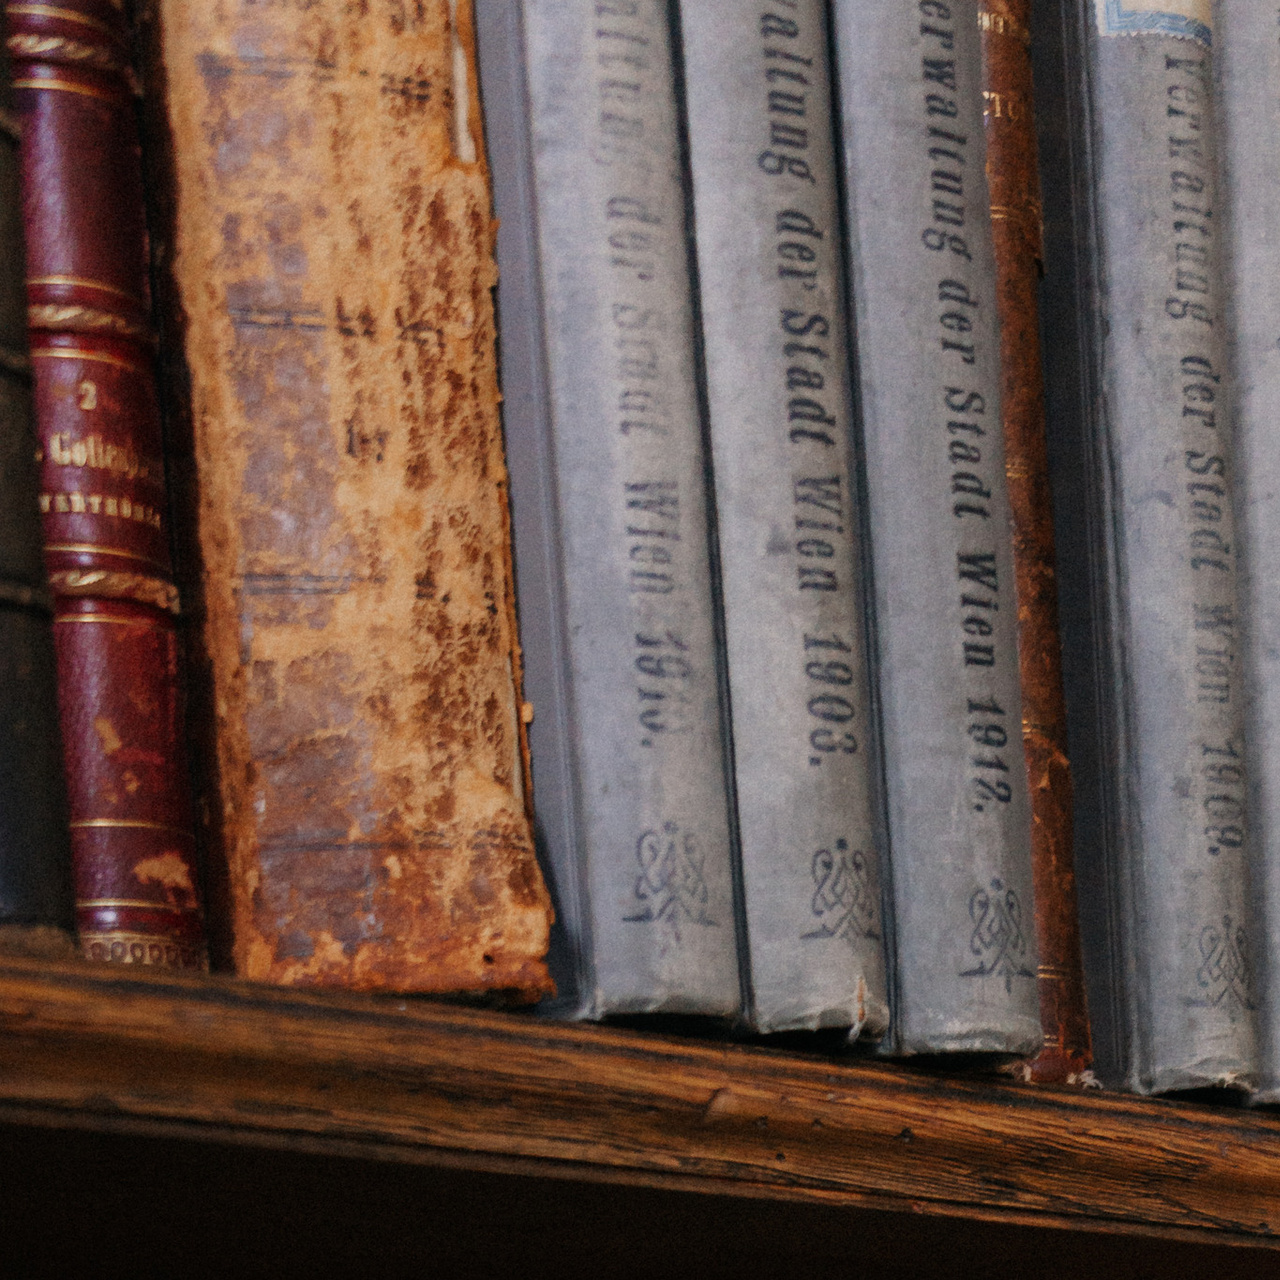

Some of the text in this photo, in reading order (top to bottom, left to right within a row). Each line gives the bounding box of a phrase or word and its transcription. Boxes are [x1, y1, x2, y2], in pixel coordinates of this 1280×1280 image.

[606, 196, 662, 282] der
[776, 208, 825, 292] der
[1165, 54, 1214, 328] Verwaltung
[780, 307, 838, 446] Stadt
[937, 276, 979, 365] der
[1179, 355, 1222, 429] der
[942, 387, 992, 520] Stadt
[1183, 449, 1231, 574] Stadt
[623, 479, 682, 596] Wien
[794, 474, 844, 593] Wien
[956, 551, 999, 668] Wien
[1193, 602, 1235, 705] Wien
[803, 632, 859, 766] 1903.
[966, 694, 1014, 814] 1912.
